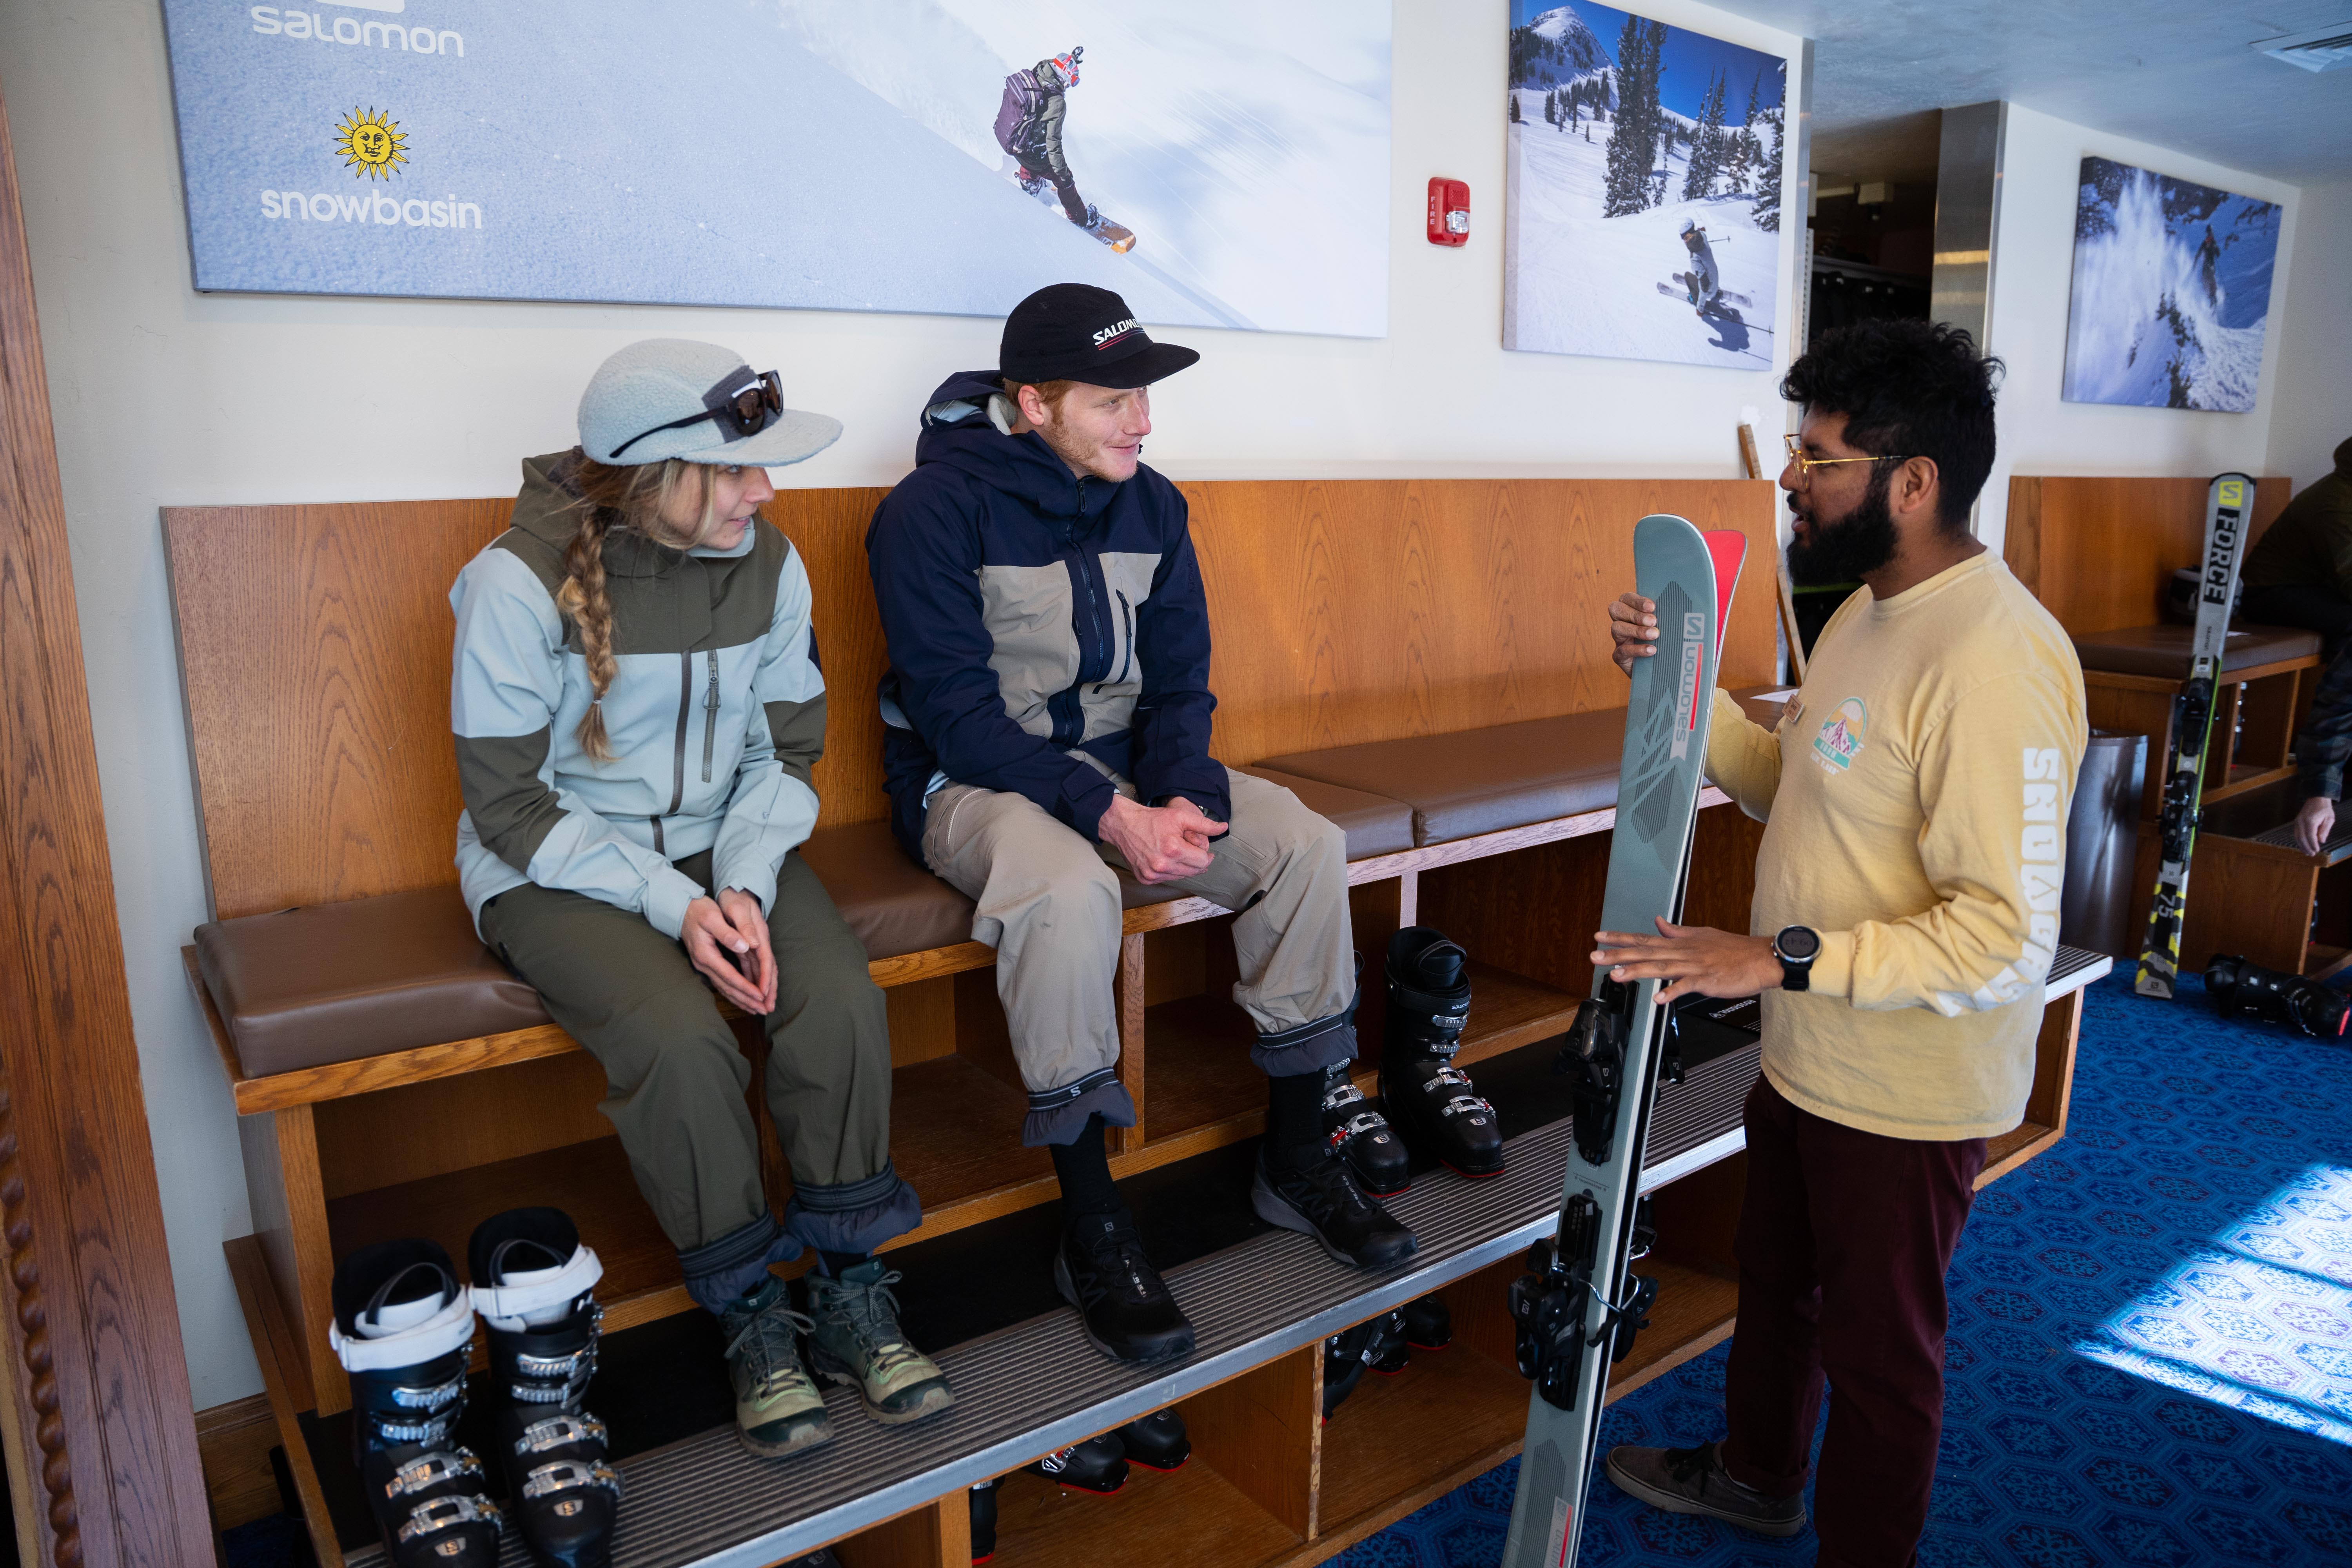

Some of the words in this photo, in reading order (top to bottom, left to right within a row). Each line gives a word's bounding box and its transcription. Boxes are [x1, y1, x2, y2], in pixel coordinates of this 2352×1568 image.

[250, 5, 465, 57] salomon
[261, 189, 482, 229] snowbasin
[1093, 318, 1142, 345] SALOMO
[2204, 515, 2239, 604] FORCE
[1676, 646, 1696, 742] salomon
[2158, 894, 2176, 919] 75
[1717, 999, 1756, 1014] ROSSIGNOL
